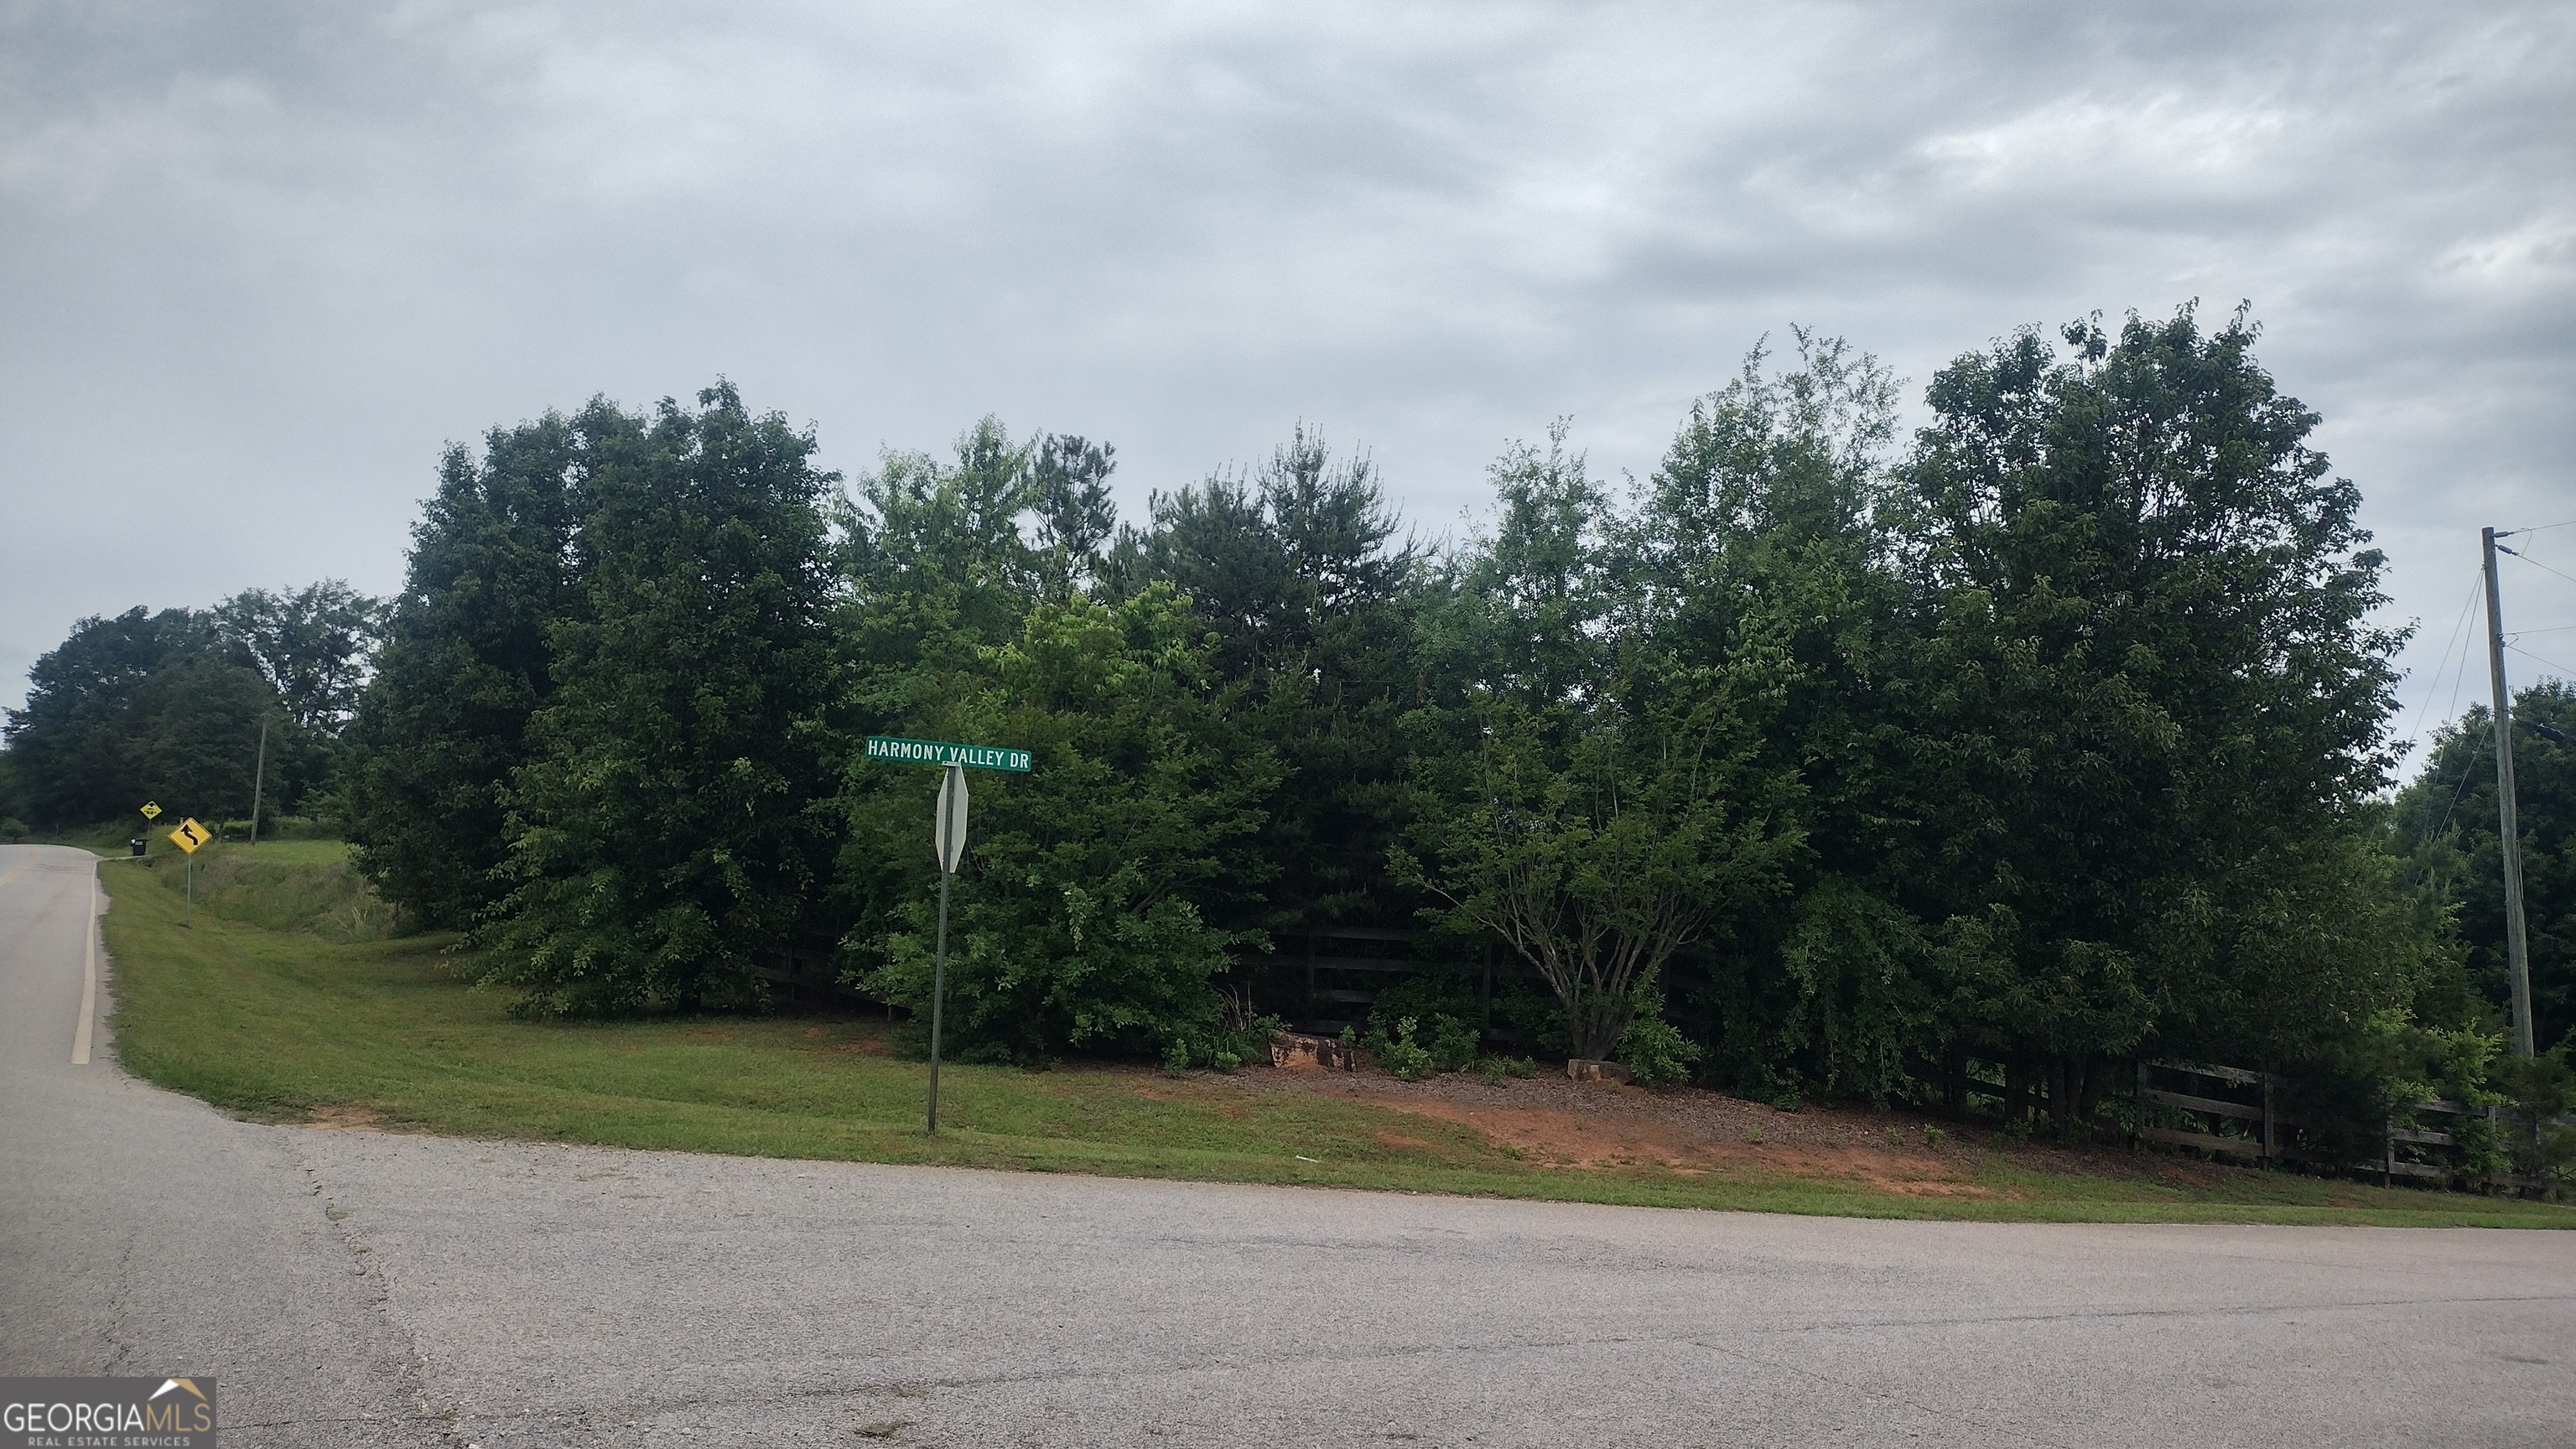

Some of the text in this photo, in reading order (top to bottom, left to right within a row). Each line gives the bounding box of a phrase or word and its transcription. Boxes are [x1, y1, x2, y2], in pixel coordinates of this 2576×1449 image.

[868, 740, 1029, 768] HARMONY VALLEY DR
